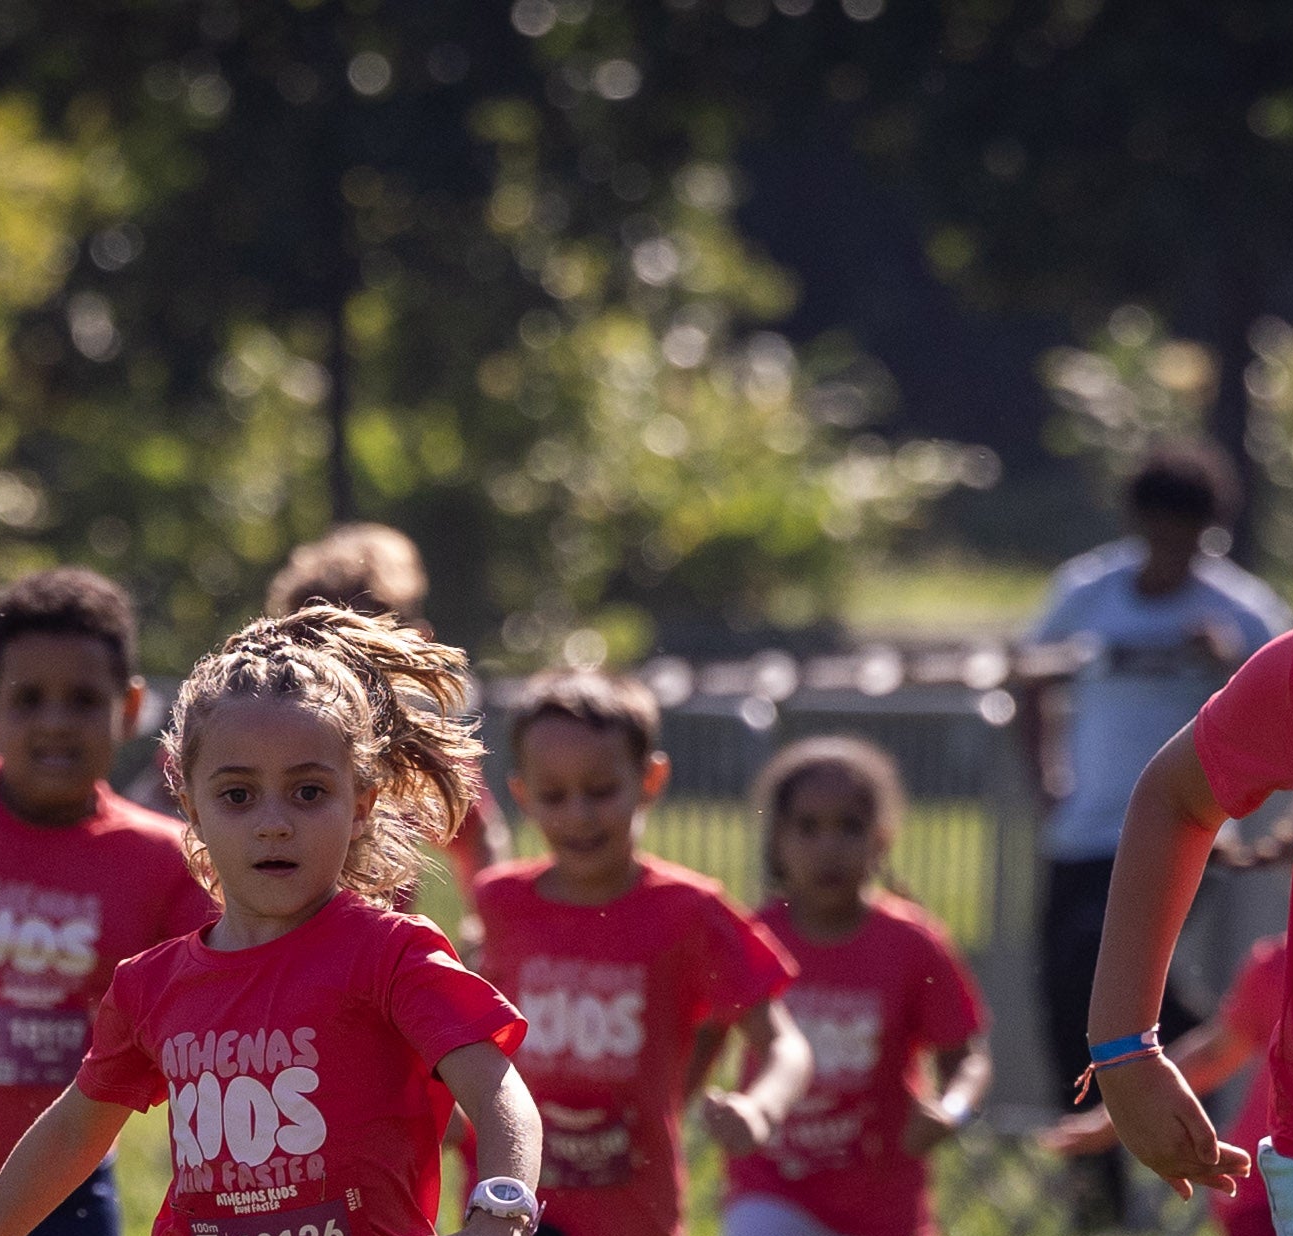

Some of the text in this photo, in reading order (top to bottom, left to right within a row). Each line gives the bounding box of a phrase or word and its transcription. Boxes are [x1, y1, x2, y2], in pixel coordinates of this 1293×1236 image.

[162, 1027, 319, 1079] ATHENAS
[168, 1066, 327, 1168] KIDS
[222, 1154, 326, 1191] FASTER
[216, 1185, 298, 1206] ATHENAS KIDS
[234, 1201, 280, 1215] RUN FASTER
[191, 1223, 218, 1233] 100m
